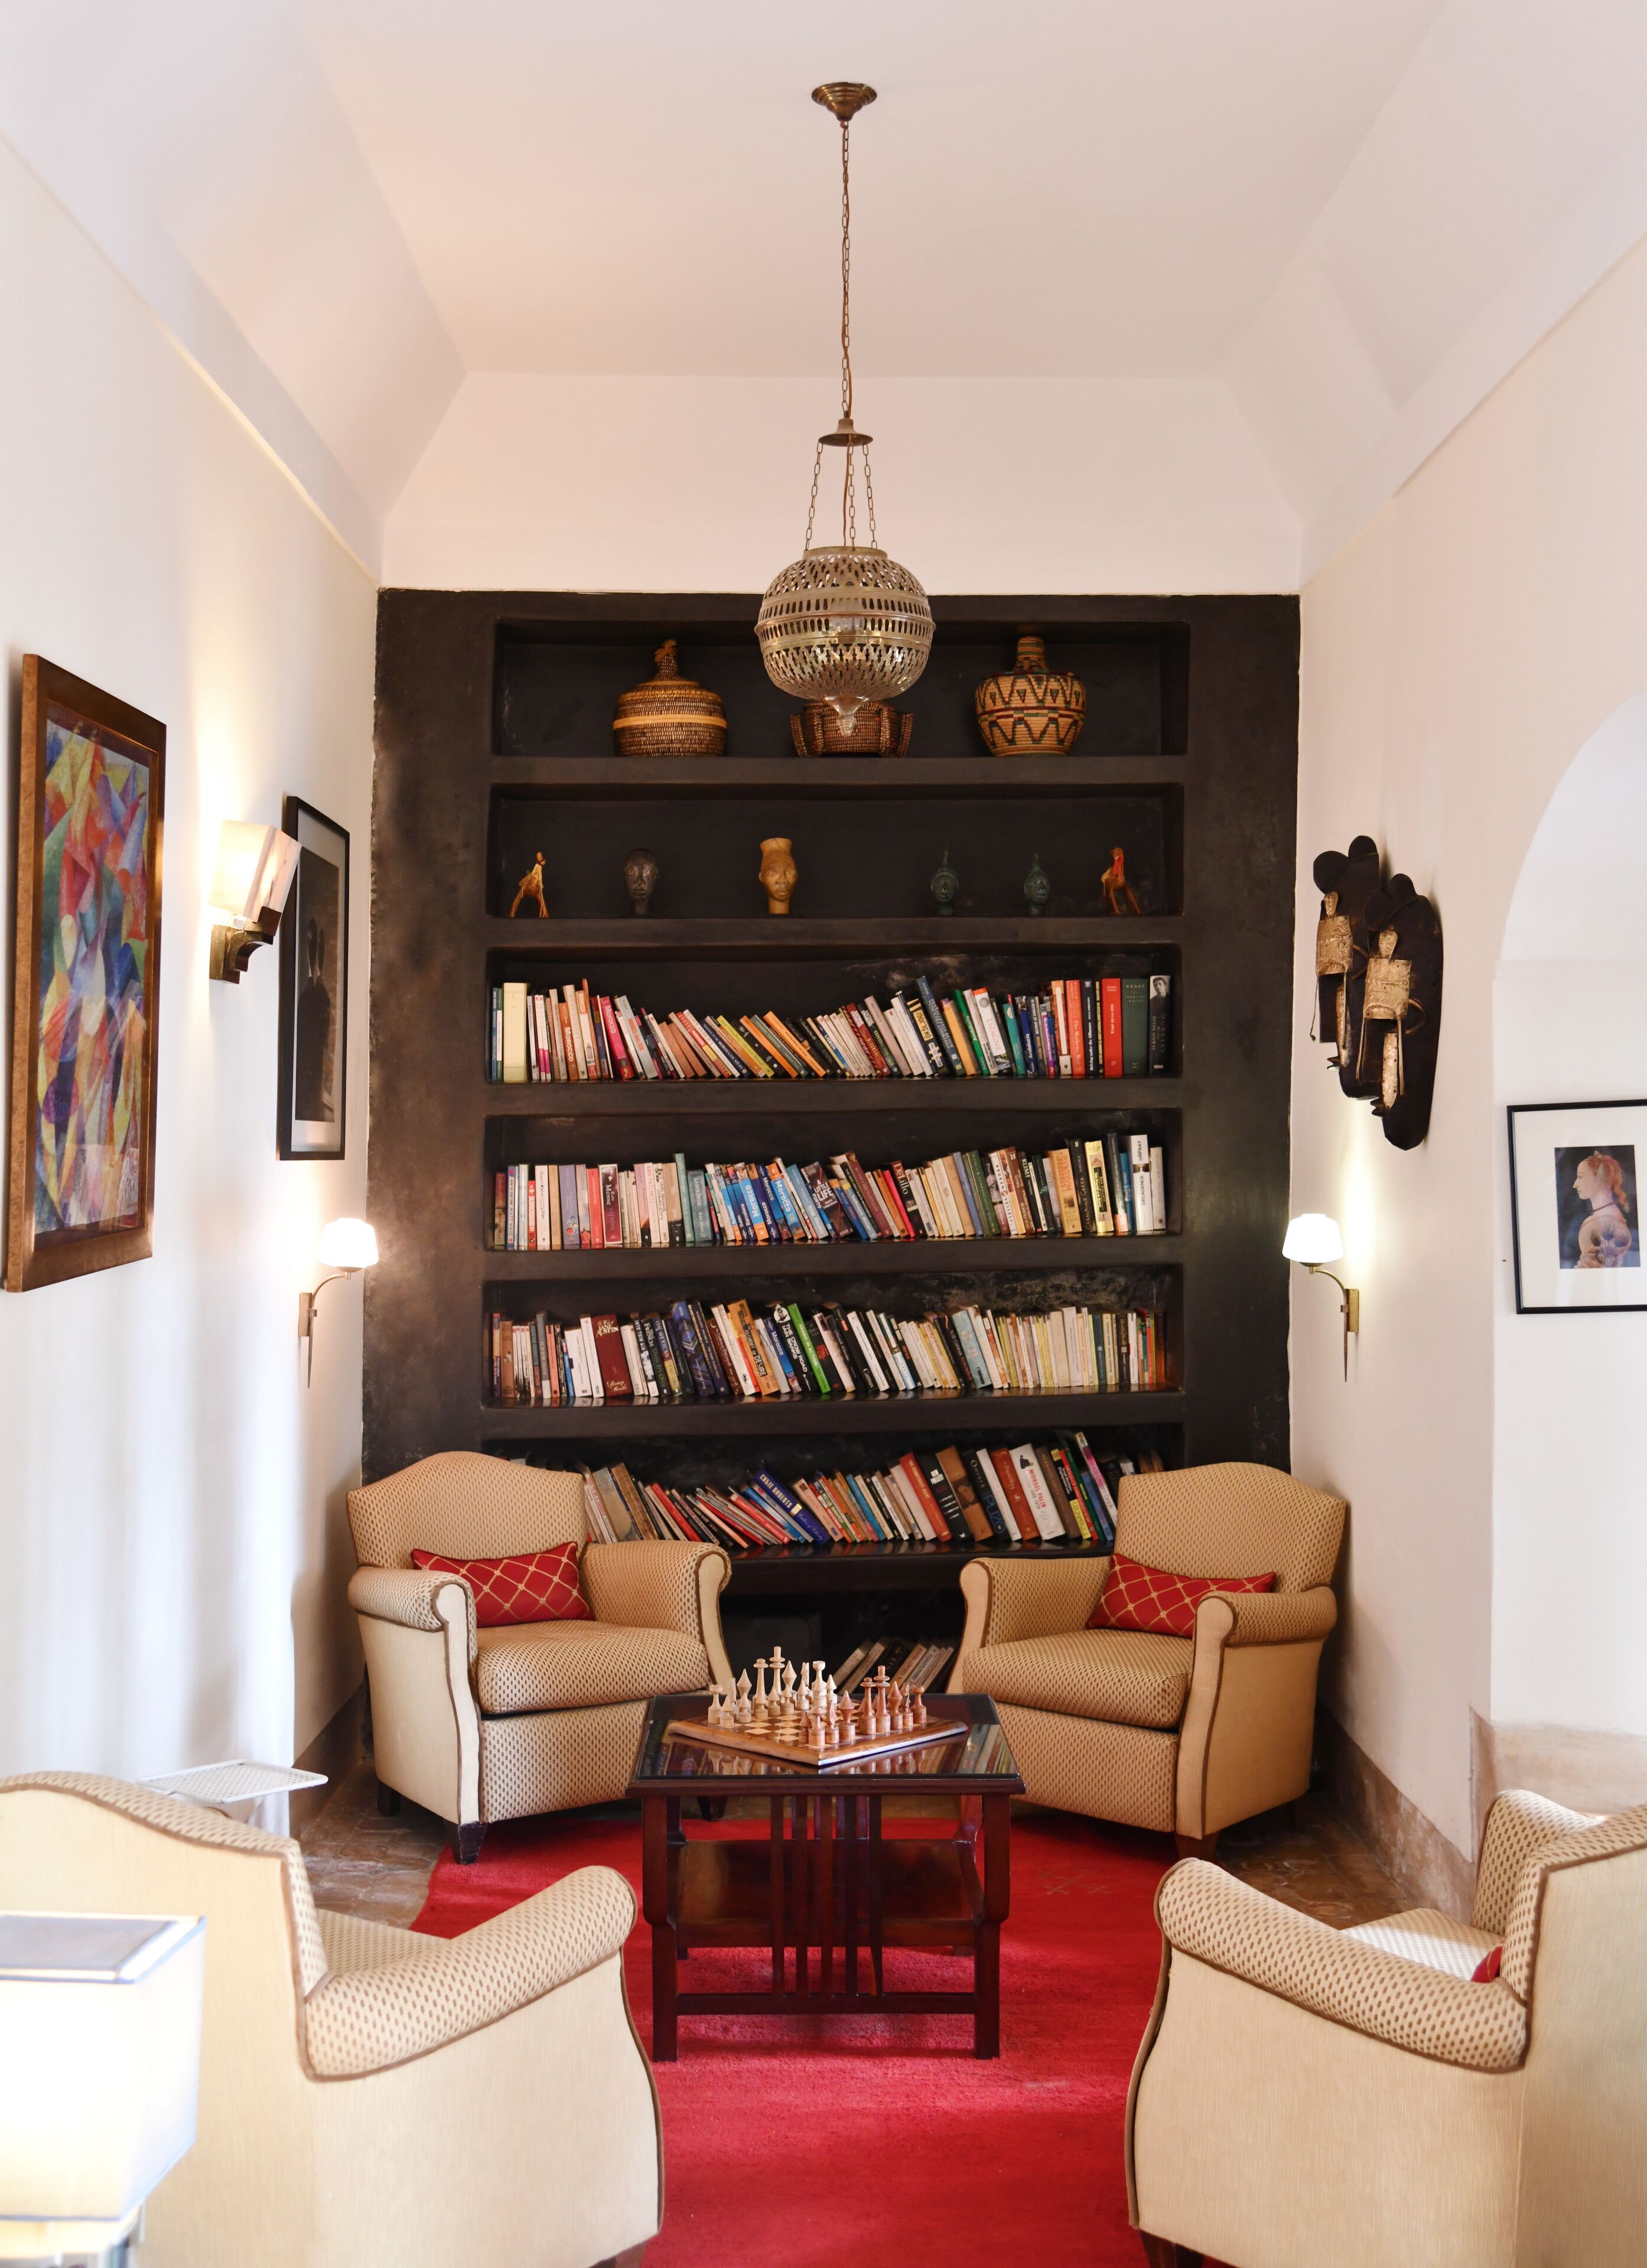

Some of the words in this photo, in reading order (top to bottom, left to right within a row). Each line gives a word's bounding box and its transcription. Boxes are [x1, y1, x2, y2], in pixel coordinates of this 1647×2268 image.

[965, 1014, 978, 1042] Andalucia
[985, 1017, 1002, 1052] ESPAGNE
[717, 1040, 736, 1060] MOROCCAN
[733, 1058, 744, 1070] ATLAS
[823, 1034, 836, 1051] LISBON
[1024, 1032, 1033, 1058] Andalucia
[891, 1162, 912, 1195] DeLillo
[1021, 1158, 1030, 1178] KLIMT
[1056, 1154, 1072, 1192] SHANTARAM
[604, 1184, 613, 1205] Mosse
[647, 1178, 655, 1204] PATCHETT
[762, 1176, 774, 1201] Morocco
[774, 1179, 792, 1213] Morocco
[813, 1181, 830, 1194] LITTLE
[816, 1187, 834, 1202] LIFE
[995, 1164, 1005, 1190] BROKEN
[1004, 1197, 1013, 1223] VESSELS
[1078, 1175, 1086, 1196] GREER
[656, 1188, 664, 1220] COMPLICITY
[743, 1184, 760, 1217] Morocco
[760, 1201, 772, 1225] Morocco
[811, 1192, 821, 1210] PORTO
[861, 1200, 872, 1219] MOVEMENT
[1082, 1196, 1092, 1230] GERMAINE
[740, 1203, 751, 1226] Barcelona
[595, 1326, 619, 1337] AUSTEN
[642, 1322, 656, 1347] FRENCH
[655, 1320, 662, 1331] ON
[658, 1331, 670, 1358] MEXICAN
[770, 1331, 785, 1356] Morocco
[781, 1325, 790, 1338] IAIN
[786, 1338, 799, 1360] BANKS
[785, 1323, 793, 1335] THE
[790, 1336, 801, 1354] CROW
[797, 1354, 808, 1373] ROAD
[798, 1323, 808, 1341] ARABIC
[807, 1347, 818, 1366] ACTION
[753, 1354, 767, 1377] DESIRE
[861, 1367, 876, 1389] Camus
[759, 1472, 775, 1490] COKIE
[771, 1486, 793, 1509] ROBERTS
[922, 1487, 930, 1500] AGENT
[1026, 1468, 1042, 1492] MICHAEL
[1035, 1492, 1047, 1509] PALIN
[1103, 1493, 1115, 1510] book
[981, 1493, 1009, 1534] PUZO
[1072, 1504, 1087, 1532] DUMMIES
